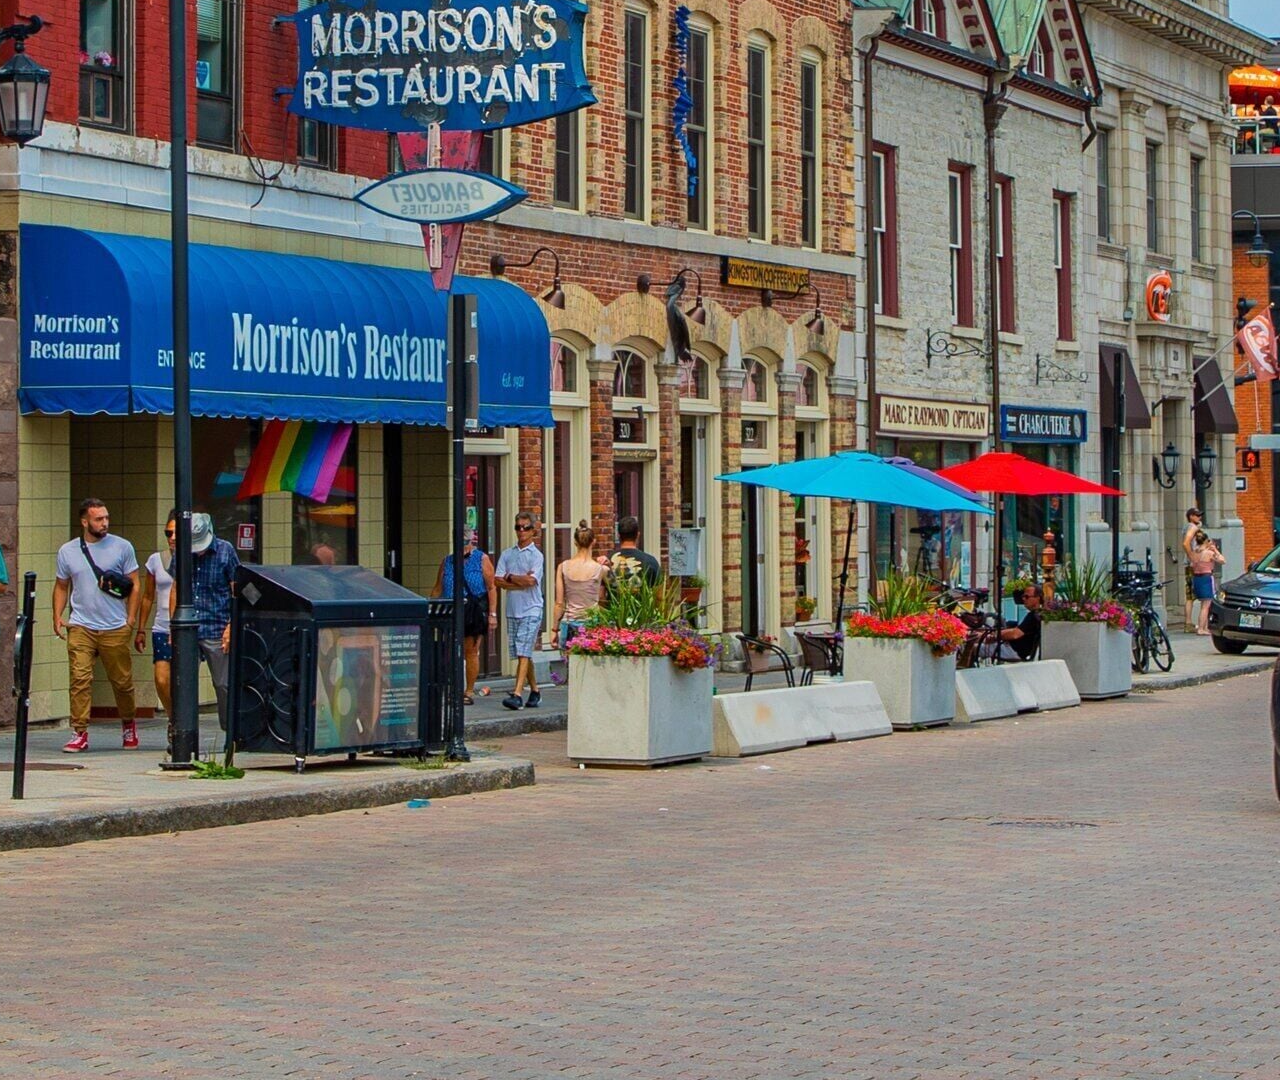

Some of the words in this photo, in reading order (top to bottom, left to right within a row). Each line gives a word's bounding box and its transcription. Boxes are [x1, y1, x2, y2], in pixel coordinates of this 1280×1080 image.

[311, 0, 557, 57] MORRISON'S
[303, 62, 566, 109] RESTAURANT
[33, 314, 119, 334] Morrison's
[30, 340, 121, 361] Restaurant
[232, 312, 357, 380] Morrison's
[364, 324, 446, 384] Restaur
[884, 404, 907, 424] MARC
[914, 407, 949, 427] RAYMOND
[953, 410, 986, 429] OPTICIAN
[1019, 414, 1072, 435] CHARCUTERIE
